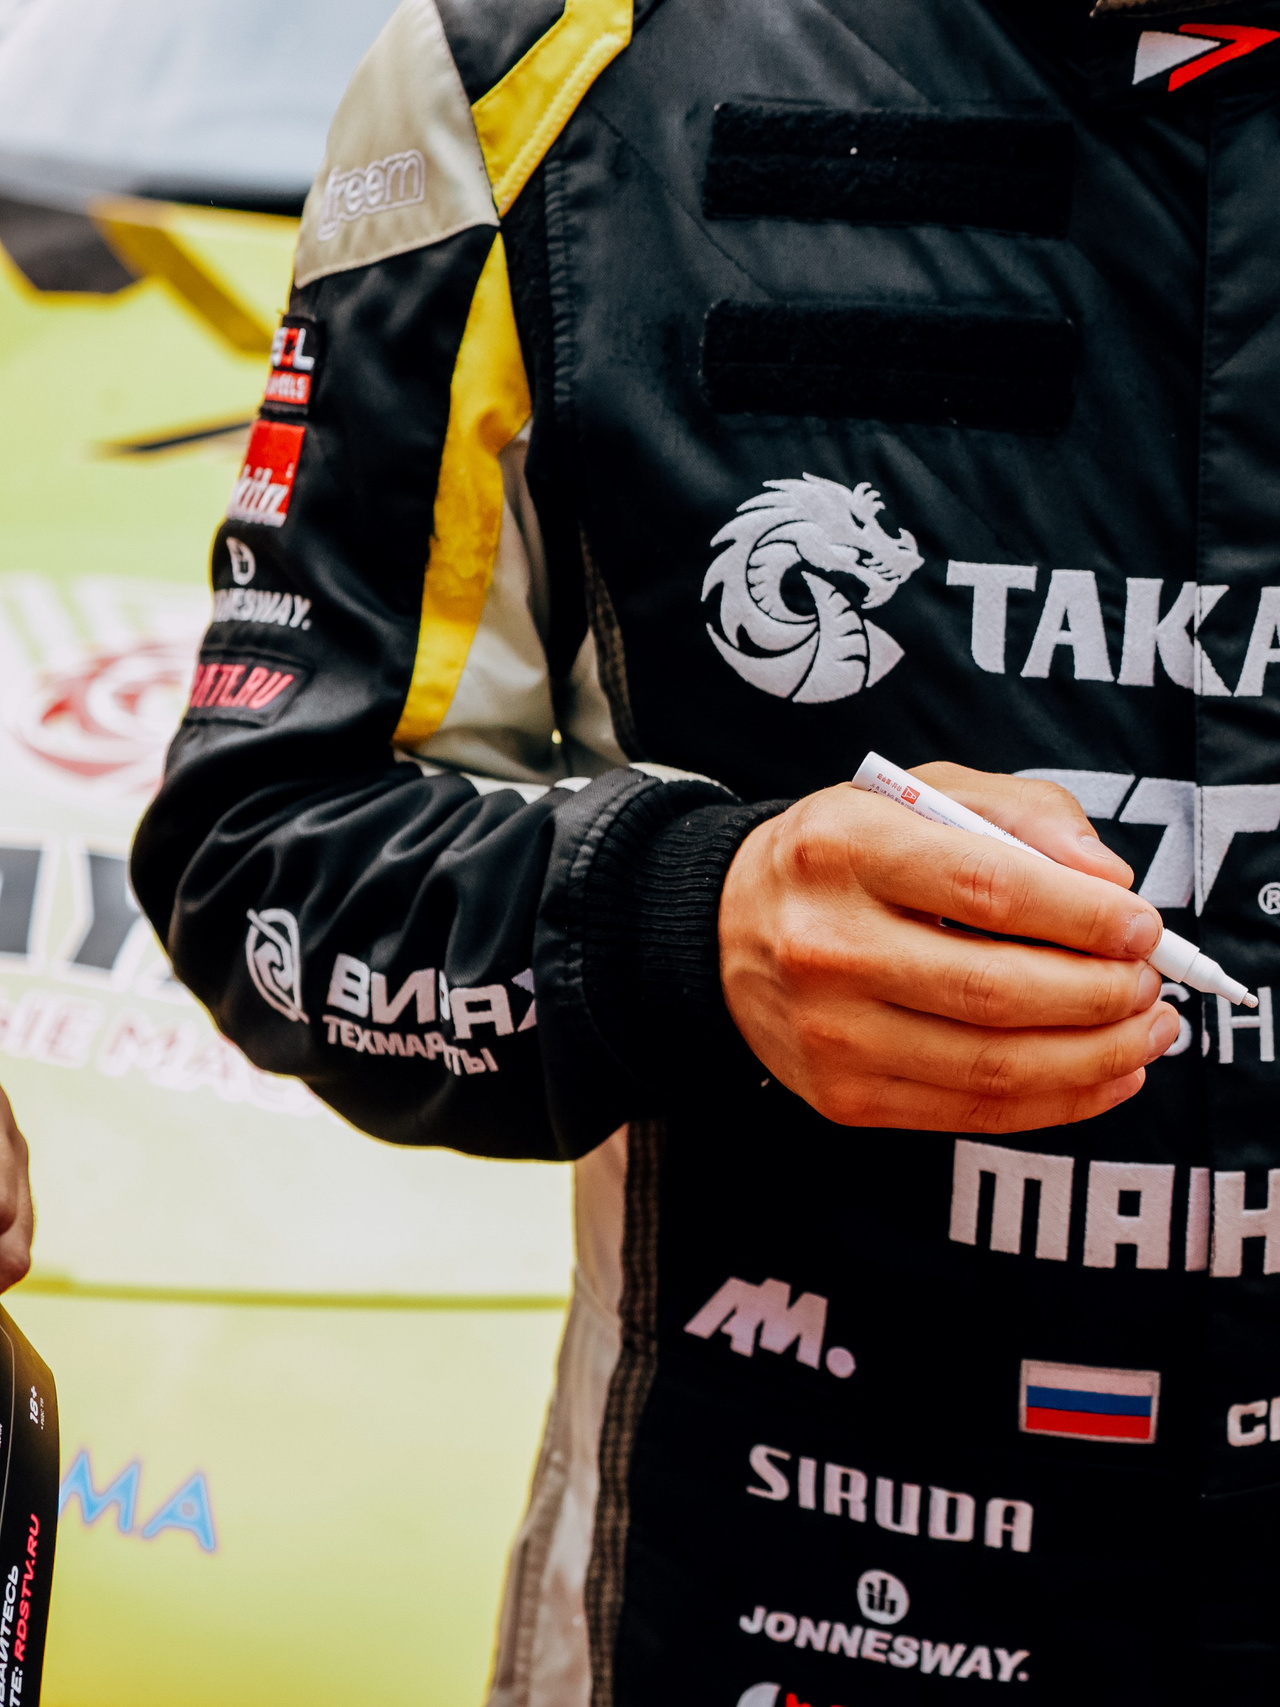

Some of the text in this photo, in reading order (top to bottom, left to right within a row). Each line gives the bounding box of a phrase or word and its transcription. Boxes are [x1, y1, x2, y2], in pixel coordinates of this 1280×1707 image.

[30, 1385, 39, 1425] 18+
[746, 1443, 1034, 1553] SIRUDA
[14, 1513, 40, 1662] RDSTV.RU
[739, 1605, 1030, 1682] JONNESWAY.
